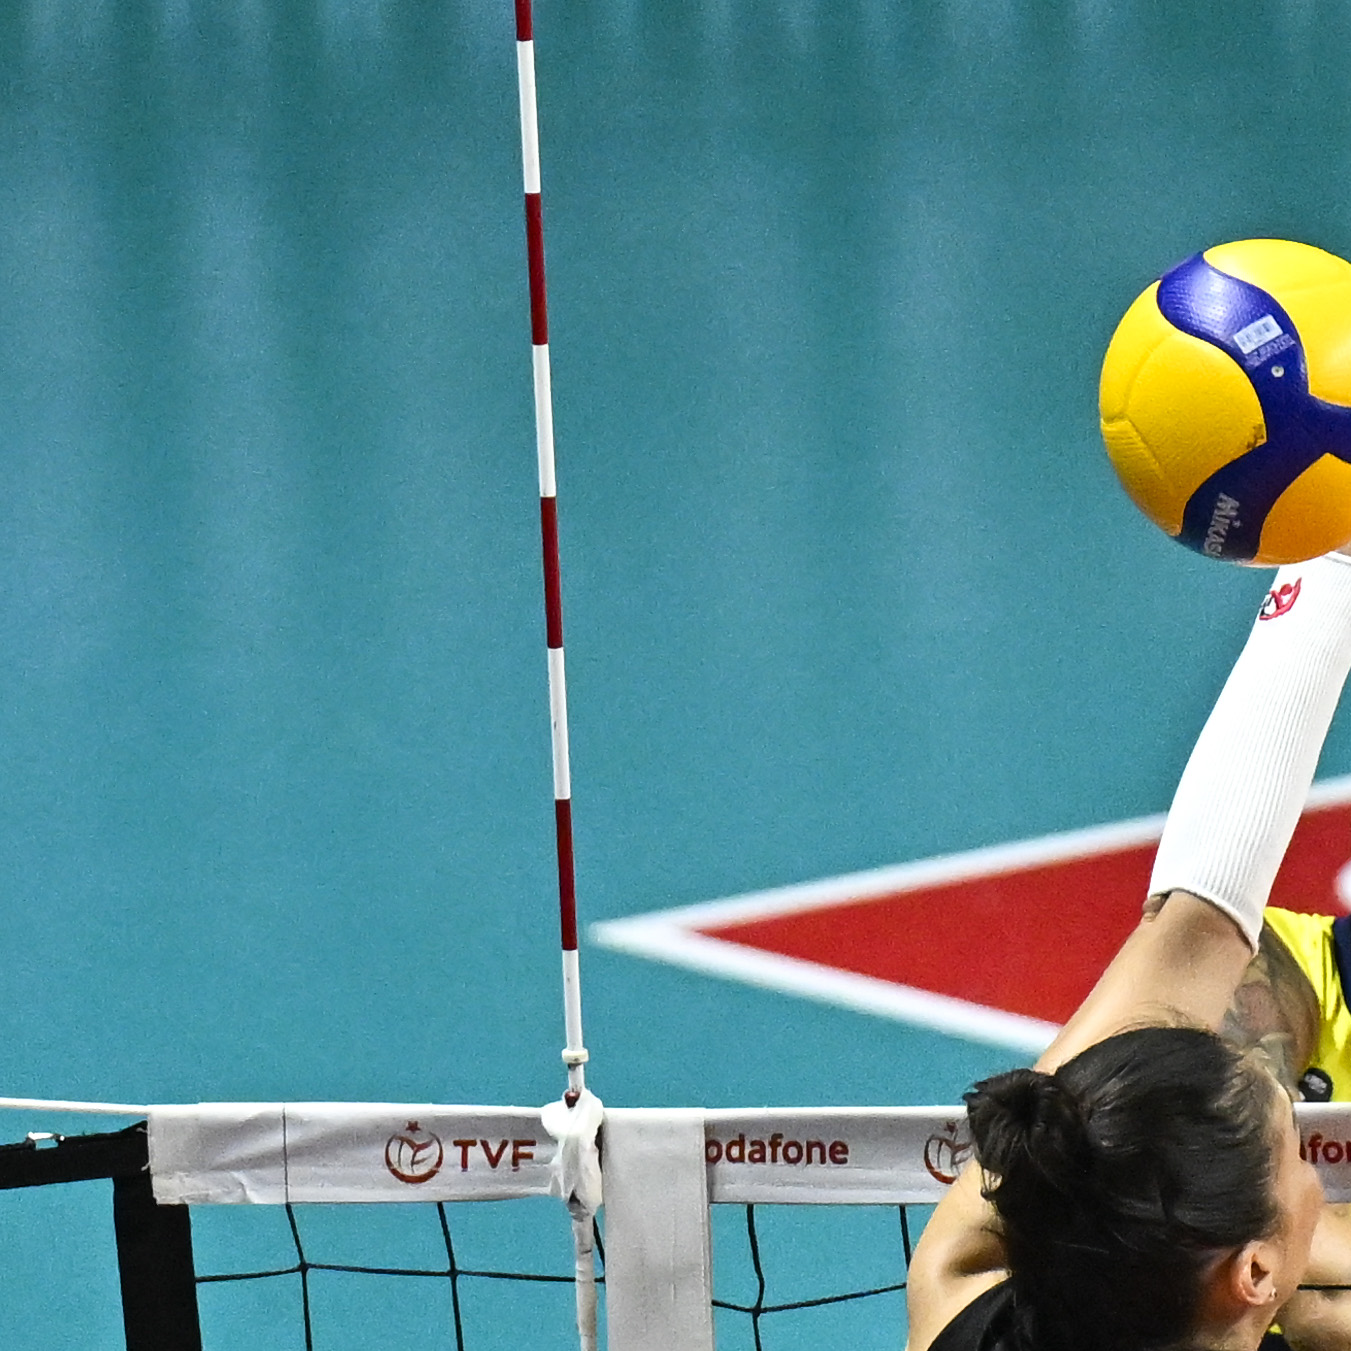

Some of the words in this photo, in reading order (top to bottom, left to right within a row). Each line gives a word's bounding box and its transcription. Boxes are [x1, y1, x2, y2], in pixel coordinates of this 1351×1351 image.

[1203, 491, 1240, 557] MIKAS
[453, 1138, 537, 1172] TVF
[704, 1132, 849, 1165] odafone
